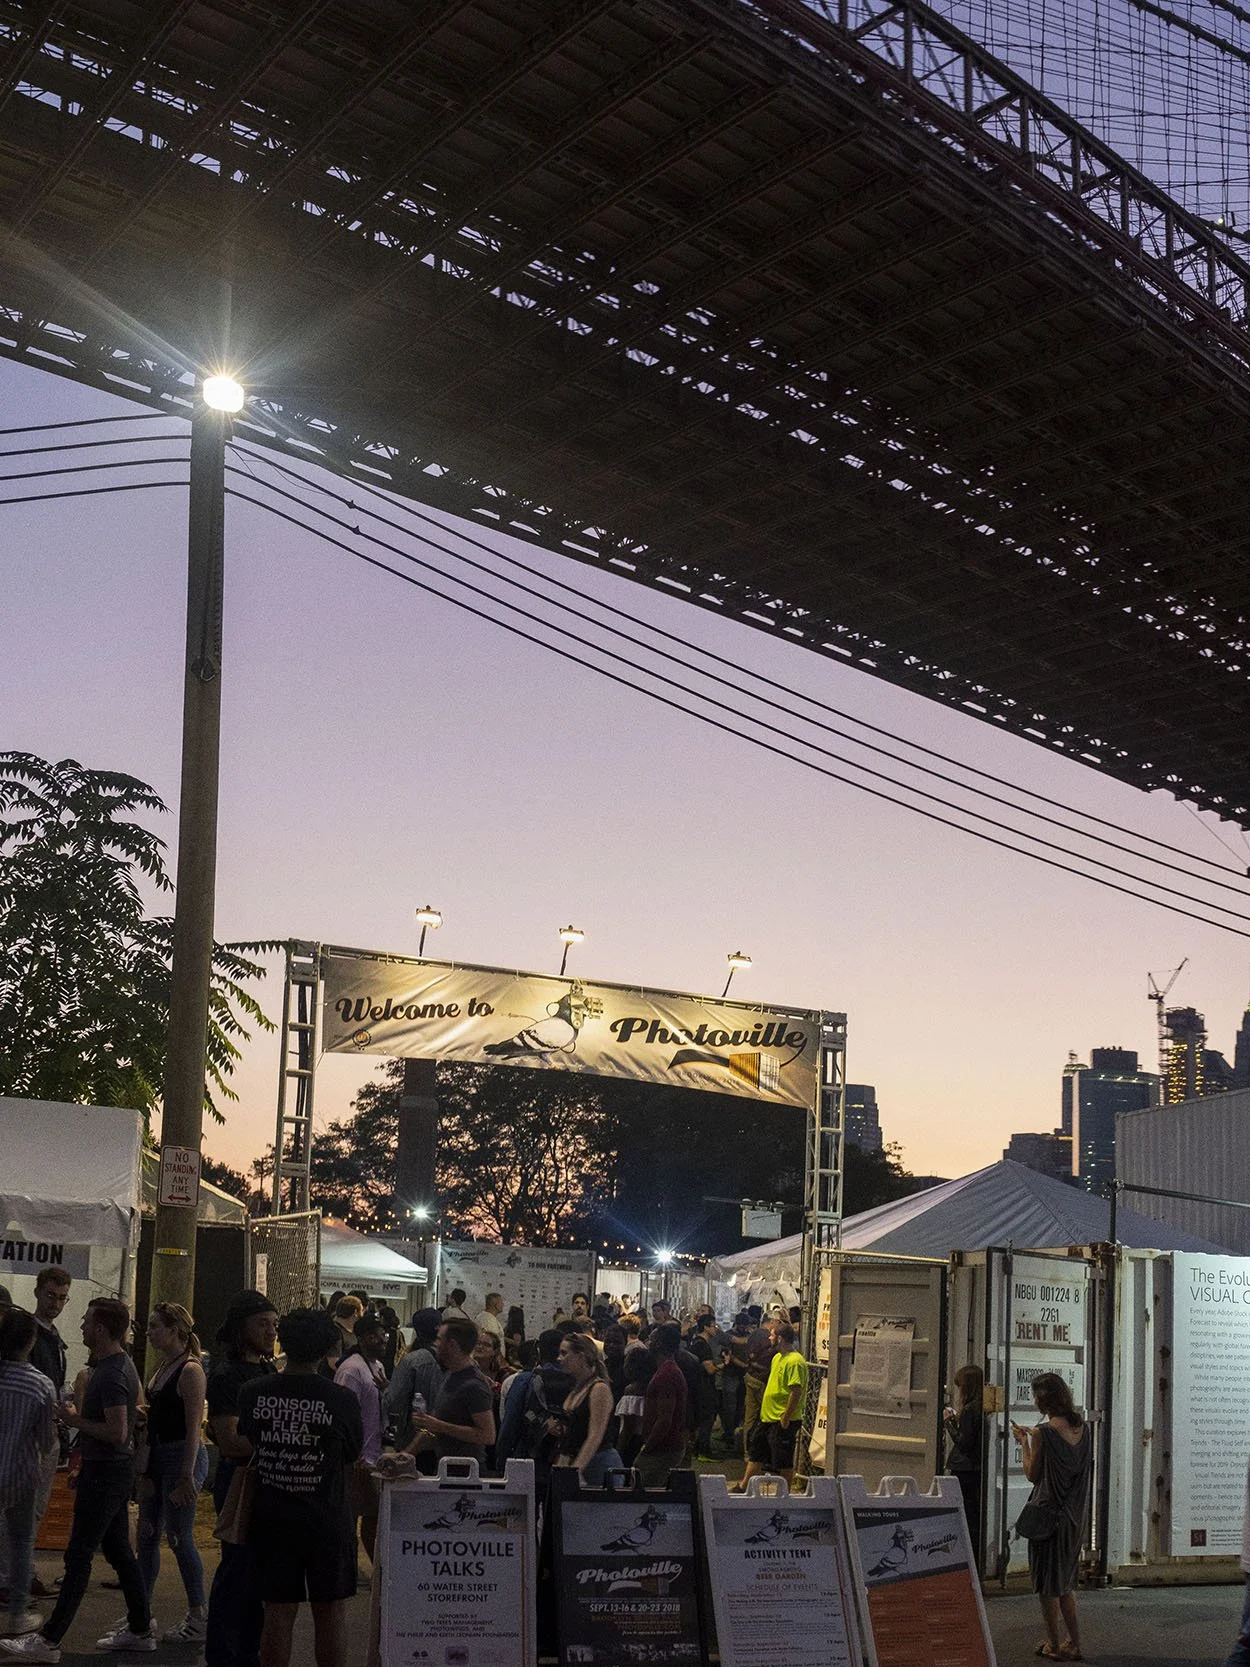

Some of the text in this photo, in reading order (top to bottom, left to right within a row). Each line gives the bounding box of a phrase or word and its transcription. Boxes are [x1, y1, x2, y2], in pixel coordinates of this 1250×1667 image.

[335, 996, 494, 1022] Welcome to
[610, 1017, 808, 1052] Photoville
[175, 1152, 189, 1163] NO
[165, 1163, 197, 1175] STANDING
[172, 1176, 189, 1185] ANY
[171, 1184, 189, 1194] TIME
[0, 1240, 64, 1264] ATION
[1190, 1268, 1215, 1283] The
[1015, 1284, 1080, 1303] NBGU 001224 8
[1190, 1286, 1239, 1304] VISUAL
[1016, 1322, 1069, 1342] RENT ME
[1016, 1386, 1030, 1401] TARE
[253, 1407, 333, 1426] SOUTHERN
[272, 1420, 310, 1434] FLEA
[261, 1430, 321, 1446] MARKET
[279, 1449, 299, 1461] boys
[402, 1540, 514, 1557] PHOTOVILLE
[745, 1550, 811, 1559] ACTIVITY TENT
[431, 1561, 485, 1577] TALKS
[576, 1560, 683, 1584] Photoville
[417, 1583, 498, 1592] 60 WATER STREET
[427, 1593, 489, 1603] STOREFRONT
[611, 1603, 629, 1612] 13-16
[638, 1603, 660, 1612] 20-23
[662, 1603, 680, 1612] 2018
